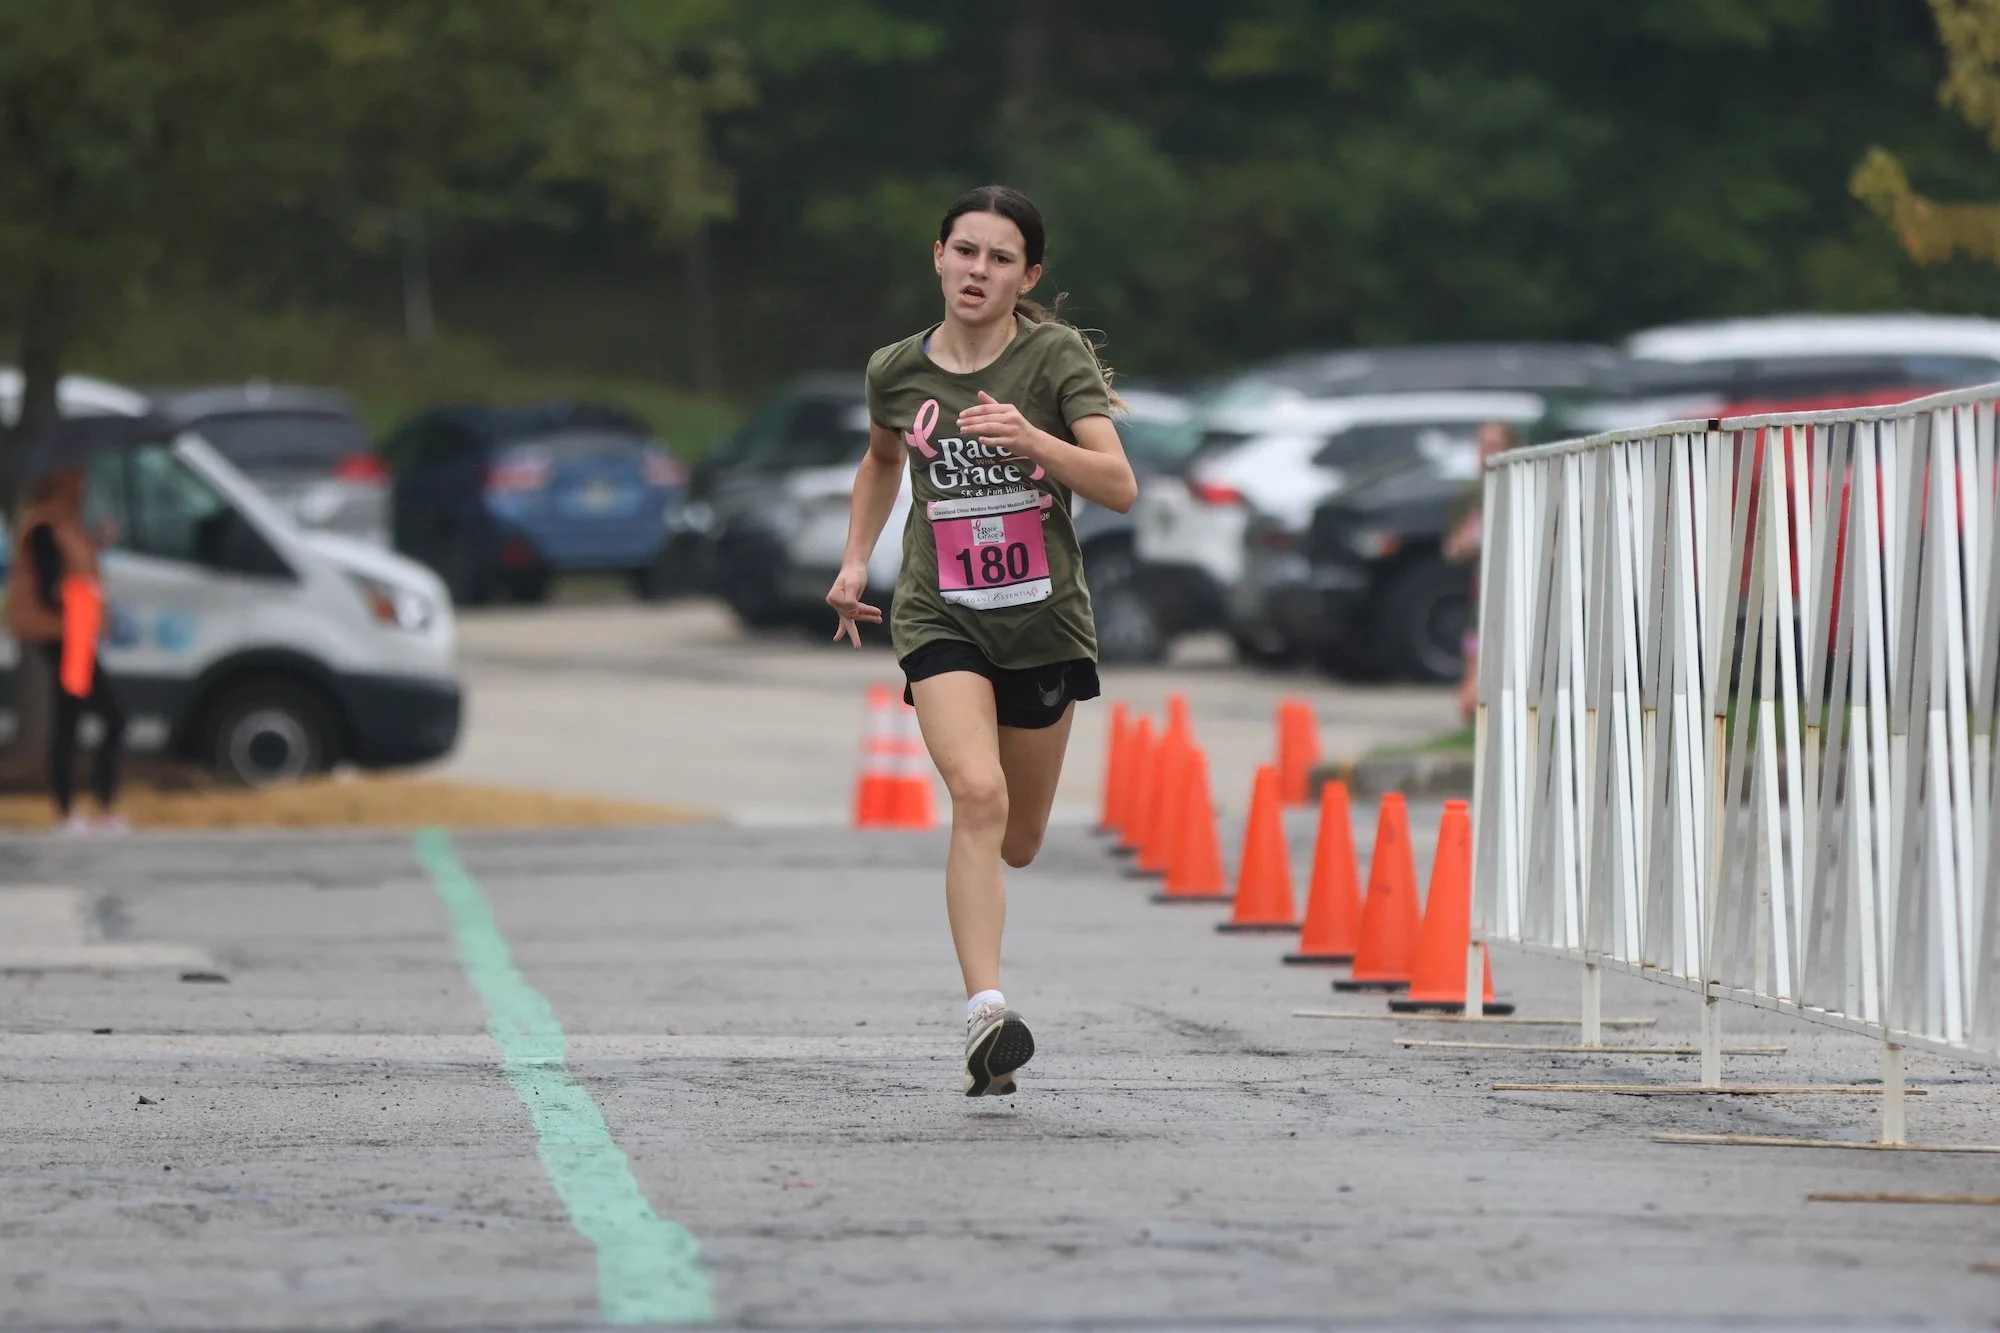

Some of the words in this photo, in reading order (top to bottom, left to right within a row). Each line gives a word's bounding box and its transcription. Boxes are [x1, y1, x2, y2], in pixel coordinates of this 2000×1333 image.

[929, 460, 1021, 489] Grace
[975, 489, 983, 497] &
[987, 488, 1002, 497] Fun
[1005, 485, 1026, 494] Walk
[970, 504, 987, 512] Medina
[988, 502, 1007, 510] Hospital
[1008, 500, 1024, 508] Medical
[981, 526, 997, 534] Race
[956, 543, 1029, 585] 180
